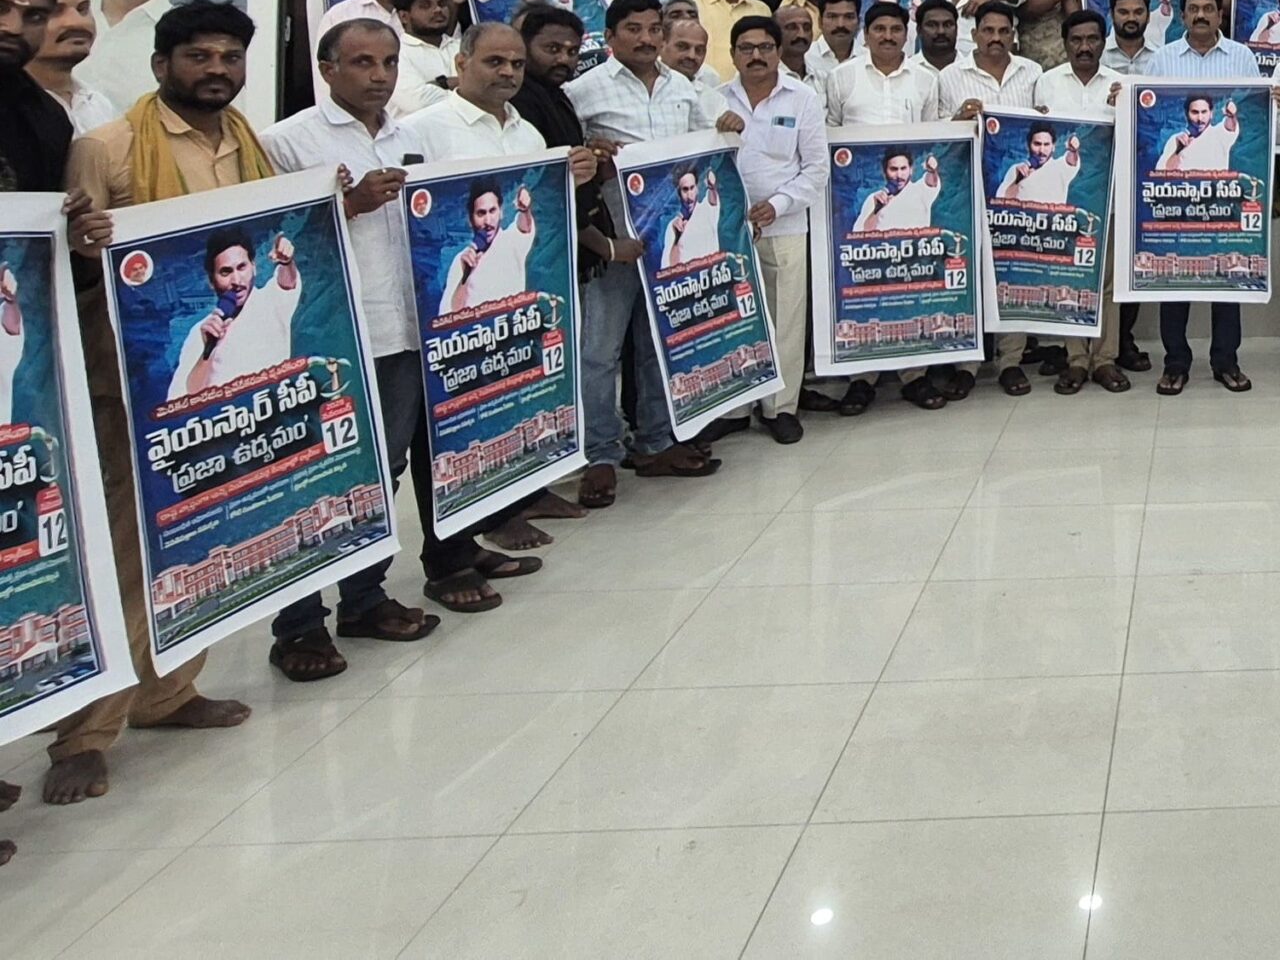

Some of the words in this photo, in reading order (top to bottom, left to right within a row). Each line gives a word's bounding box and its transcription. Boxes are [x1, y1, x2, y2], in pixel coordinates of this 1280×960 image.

[1243, 214, 1260, 228] 12
[1076, 249, 1094, 264] 12
[947, 270, 965, 286] 12
[740, 294, 756, 316] 12
[545, 346, 563, 373] 12
[277, 372, 316, 412] సీపీ
[326, 417, 356, 449] 12
[43, 512, 67, 550] 12
